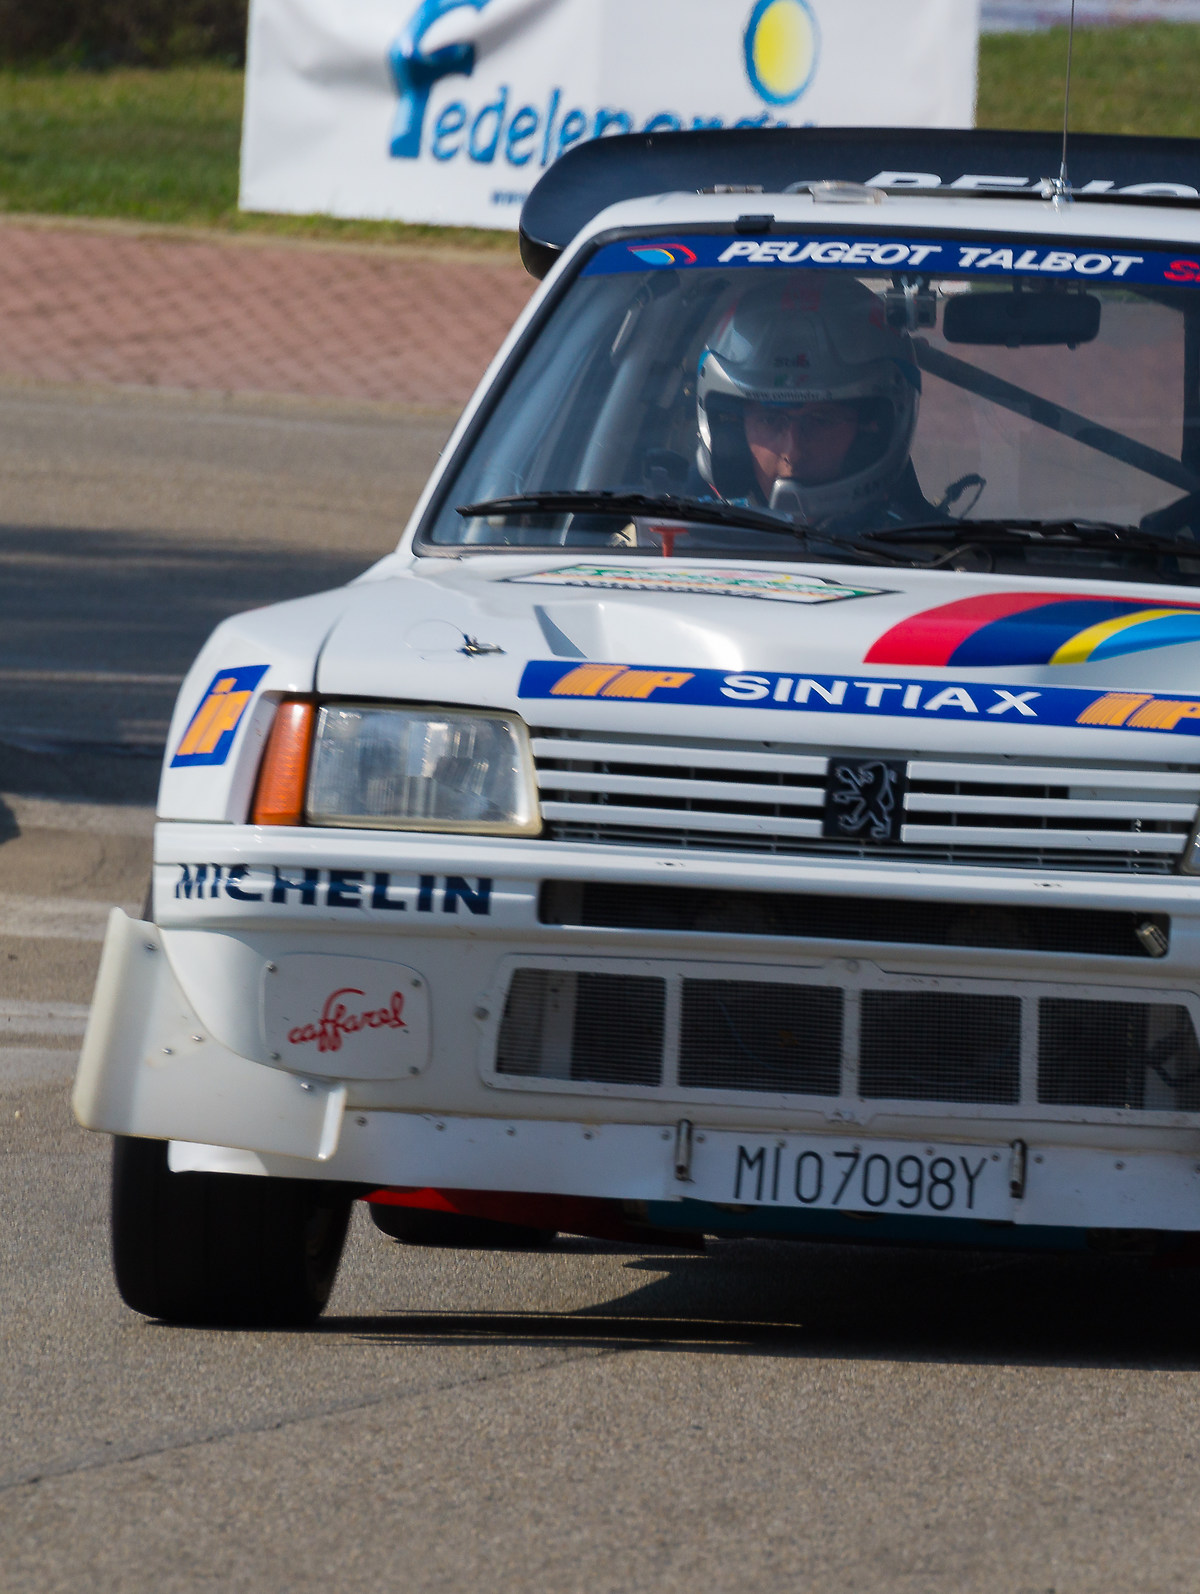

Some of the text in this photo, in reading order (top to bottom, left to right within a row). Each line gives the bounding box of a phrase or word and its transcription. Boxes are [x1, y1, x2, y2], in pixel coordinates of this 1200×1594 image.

[717, 241, 942, 265] PEUGEOT
[958, 246, 1143, 276] TALBOT
[720, 674, 1042, 717] SINTIAX
[175, 863, 493, 916] MICHELIN
[287, 987, 408, 1053] caffarel
